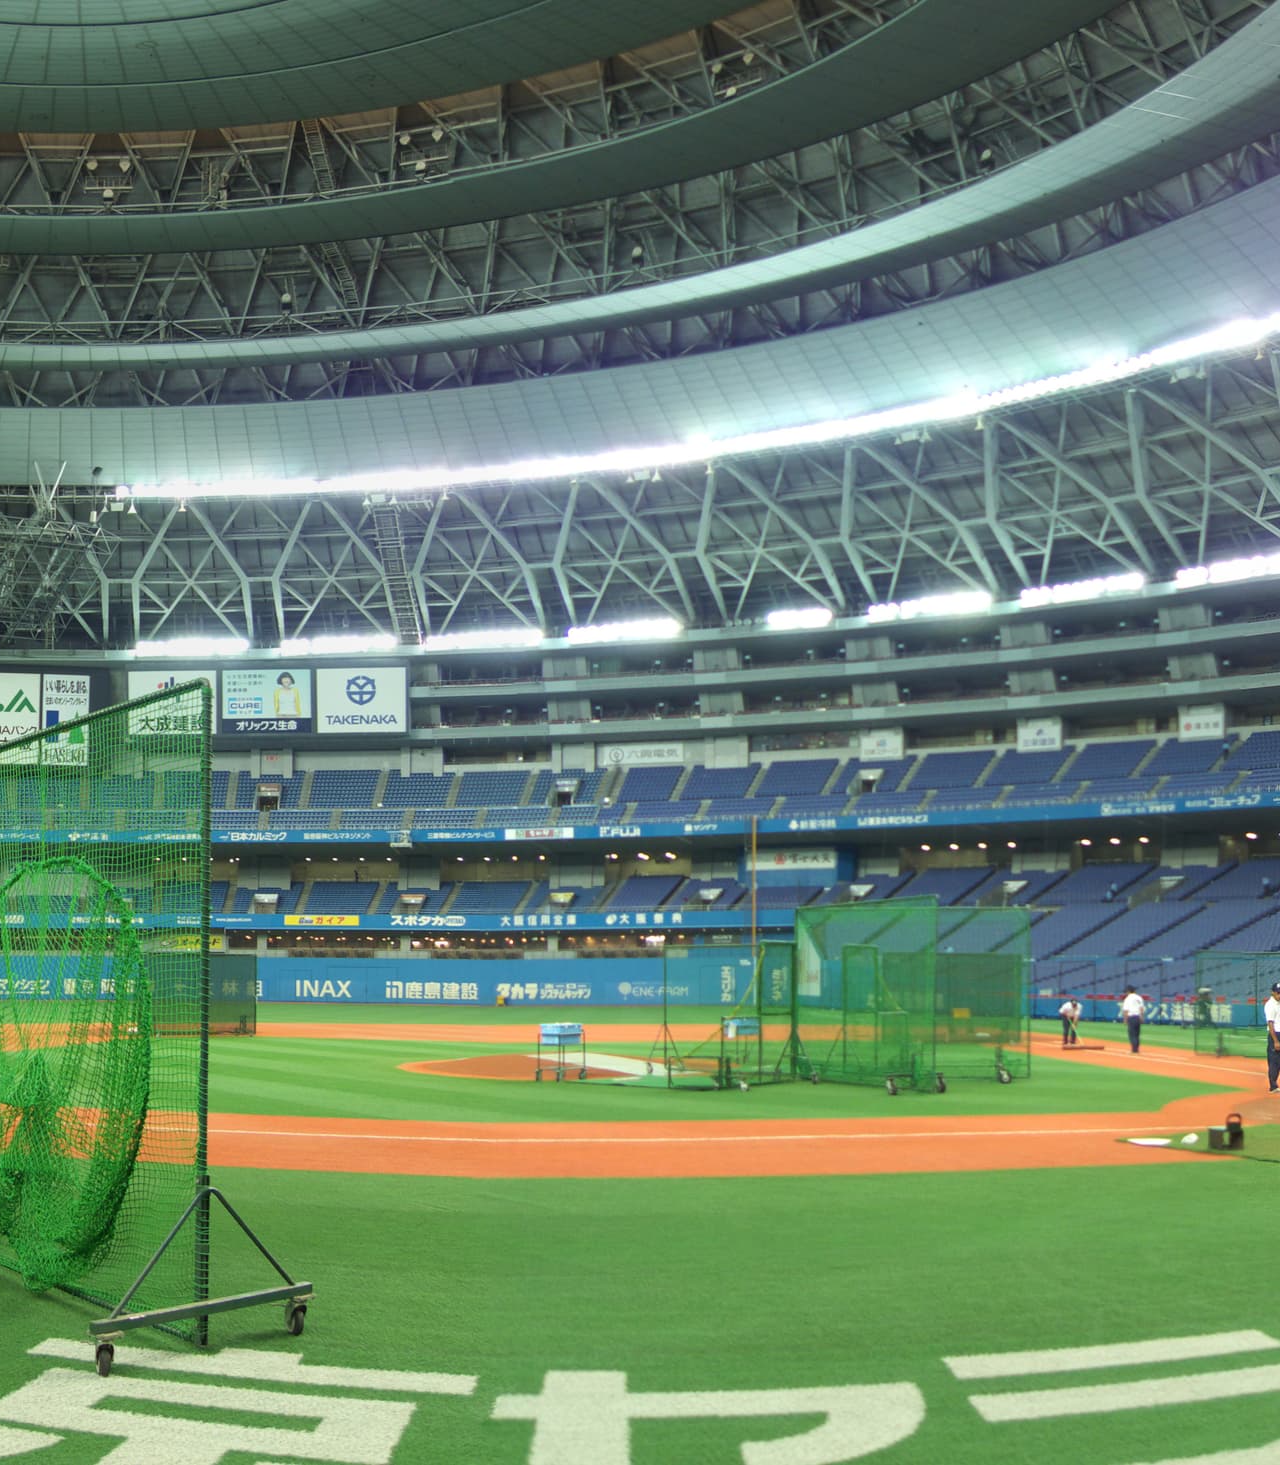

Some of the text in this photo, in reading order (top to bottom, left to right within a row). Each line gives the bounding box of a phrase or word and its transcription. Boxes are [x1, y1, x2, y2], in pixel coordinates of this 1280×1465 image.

[326, 714, 397, 725] TAKENAKA
[236, 720, 297, 731] オリックス生命
[231, 832, 287, 841] 日本カルミック
[610, 827, 640, 838] FUJI
[315, 916, 345, 925] ガイア
[391, 915, 445, 926] スポタカ
[295, 980, 352, 998] INAX
[405, 980, 479, 1000] 鹿島建設
[496, 983, 538, 1000] タカラ
[632, 986, 689, 997] ENE-FARM
